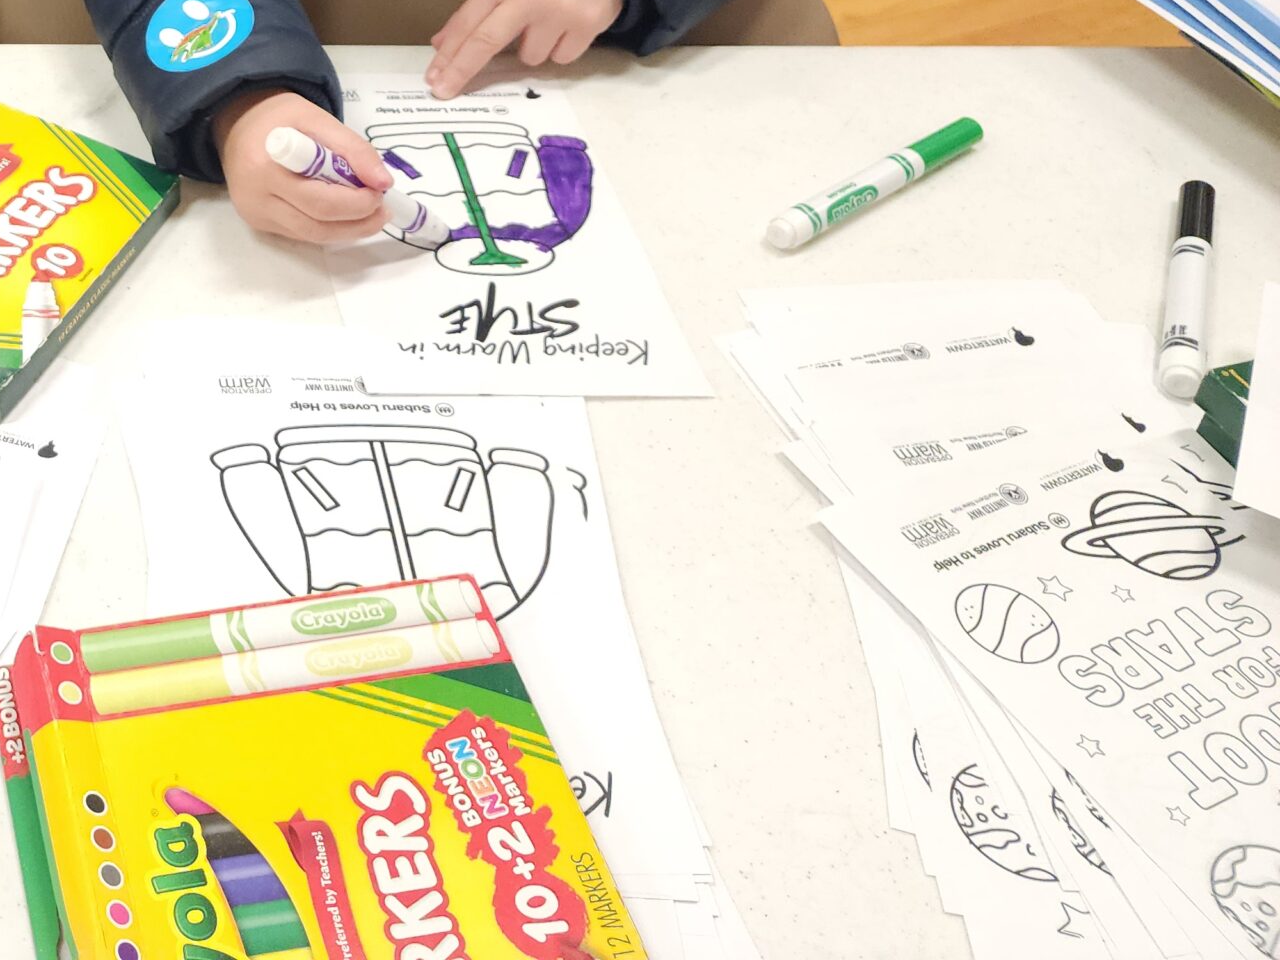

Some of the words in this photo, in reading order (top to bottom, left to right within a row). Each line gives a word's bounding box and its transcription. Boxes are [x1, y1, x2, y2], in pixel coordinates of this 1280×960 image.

[36, 246, 77, 276] 10
[439, 281, 580, 342] STYLE
[397, 341, 425, 361] in
[433, 340, 530, 365] Warm
[544, 334, 649, 366] Keeping
[946, 336, 1012, 354] WATERTOWN
[218, 377, 271, 388] warm
[221, 387, 272, 395] OPERATION
[305, 383, 322, 391] WAY
[324, 383, 354, 392] UNITED
[290, 401, 320, 412] Help
[324, 402, 336, 411] to
[340, 403, 379, 413] Loves
[383, 404, 431, 414] Subaru
[893, 443, 948, 460] warm
[902, 454, 953, 467] OPERATION
[1040, 463, 1103, 491] WATERTOWN
[969, 508, 986, 521] WAY
[985, 498, 1010, 516] UNITED
[901, 516, 954, 543] warm
[914, 527, 960, 549] OPERATION
[1007, 521, 1050, 546] Subaru
[961, 549, 977, 560] to
[974, 538, 1010, 556] Loves
[934, 556, 964, 573] Help
[299, 603, 383, 628] Crayola
[314, 645, 398, 669] Crayola
[1059, 589, 1271, 708] STARS
[1133, 683, 1225, 739] THE
[6, 738, 25, 763] +2
[447, 738, 508, 819] NEON
[471, 726, 531, 816] Markers
[426, 748, 482, 827] BONUS
[311, 831, 332, 888] Teachers!
[325, 889, 337, 907] by
[570, 852, 624, 929] MARKERS
